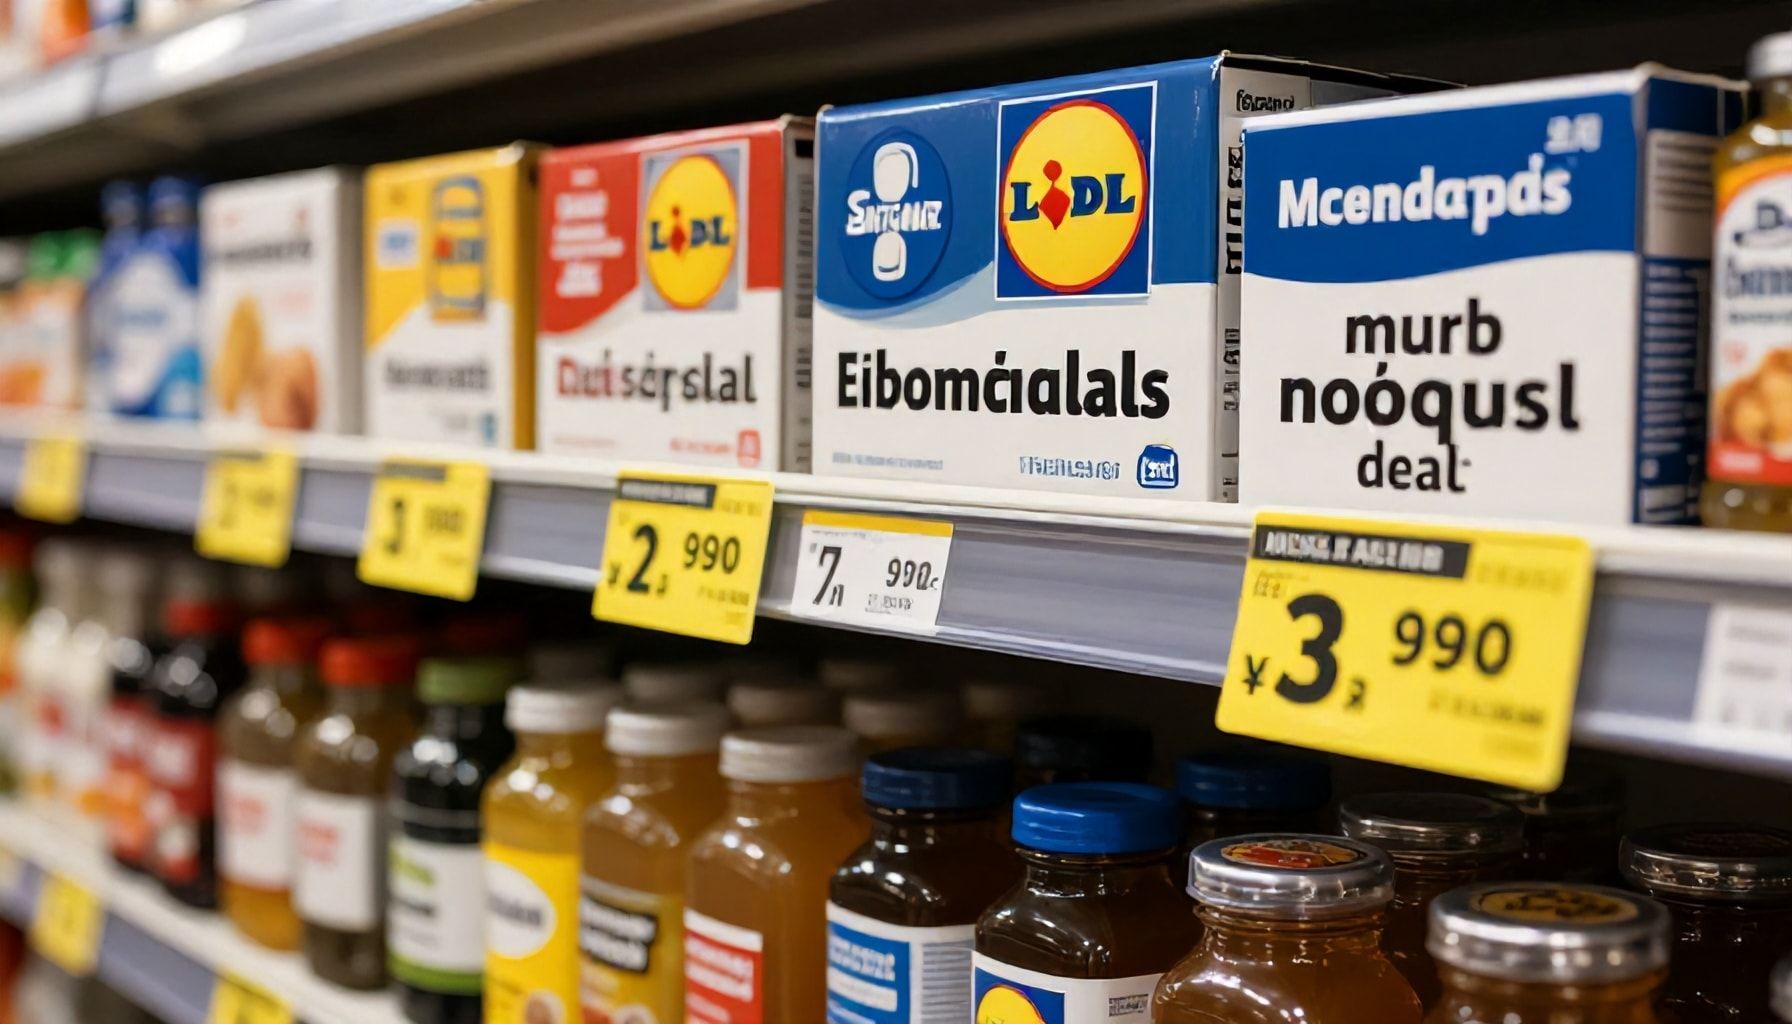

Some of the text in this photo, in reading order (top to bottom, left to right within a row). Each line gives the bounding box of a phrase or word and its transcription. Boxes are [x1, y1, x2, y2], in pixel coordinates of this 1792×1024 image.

[1345, 297, 1504, 355] murb
[626, 524, 658, 594] 2
[684, 531, 741, 574] 990
[1274, 593, 1343, 705] 3
[1392, 610, 1513, 676] 990
